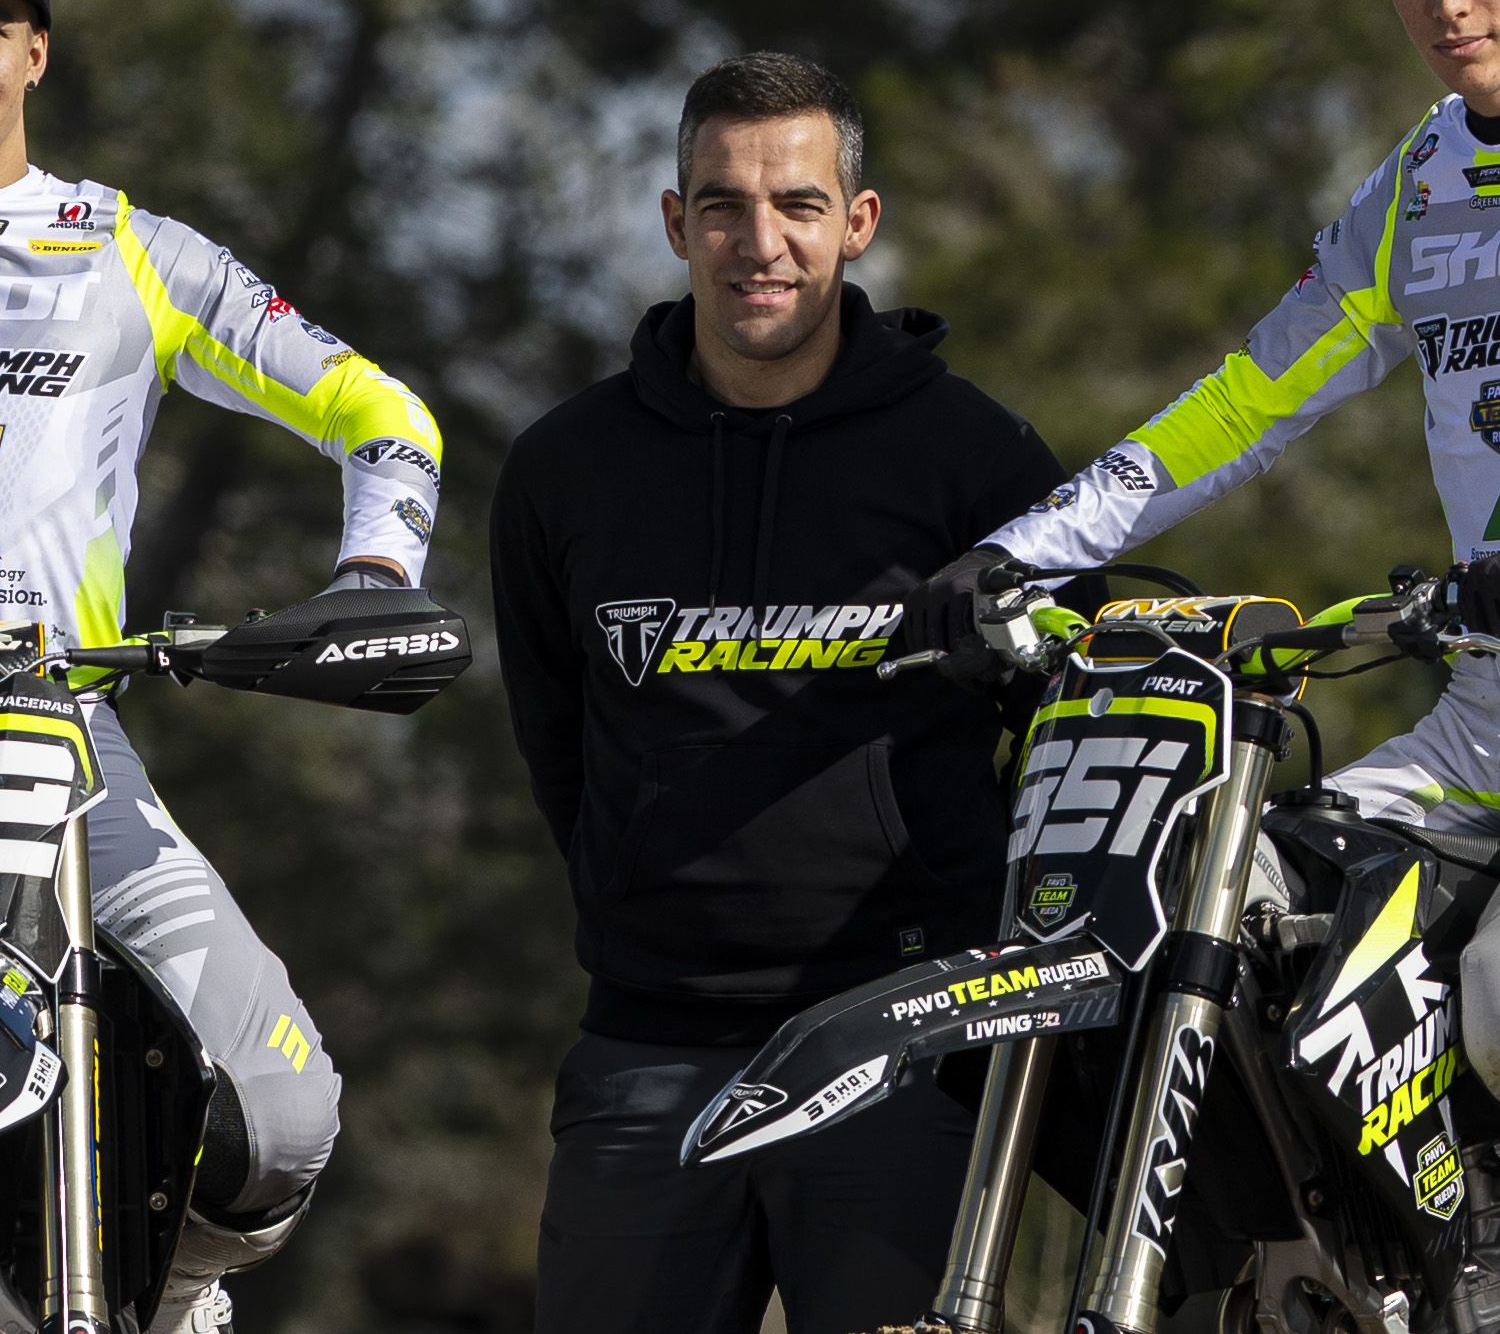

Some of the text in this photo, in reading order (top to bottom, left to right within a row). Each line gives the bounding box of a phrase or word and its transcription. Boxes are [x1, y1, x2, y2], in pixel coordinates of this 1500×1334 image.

[607, 606, 658, 620] TRIUMPH
[672, 603, 904, 642] TRIUMPH
[315, 631, 460, 664] ACERBIS
[657, 638, 888, 674] RACING
[1142, 676, 1202, 695] PRAT
[1006, 737, 1190, 865] 351
[1037, 890, 1068, 902] TEAM
[892, 957, 1100, 1021] PAVO TEAM RUEDA
[966, 1015, 1032, 1041] LIVING
[823, 1069, 870, 1103] SHOT
[1424, 1143, 1446, 1167] PAVO
[1422, 1157, 1456, 1192] TEAM
[1433, 1181, 1456, 1208] RUEDA
